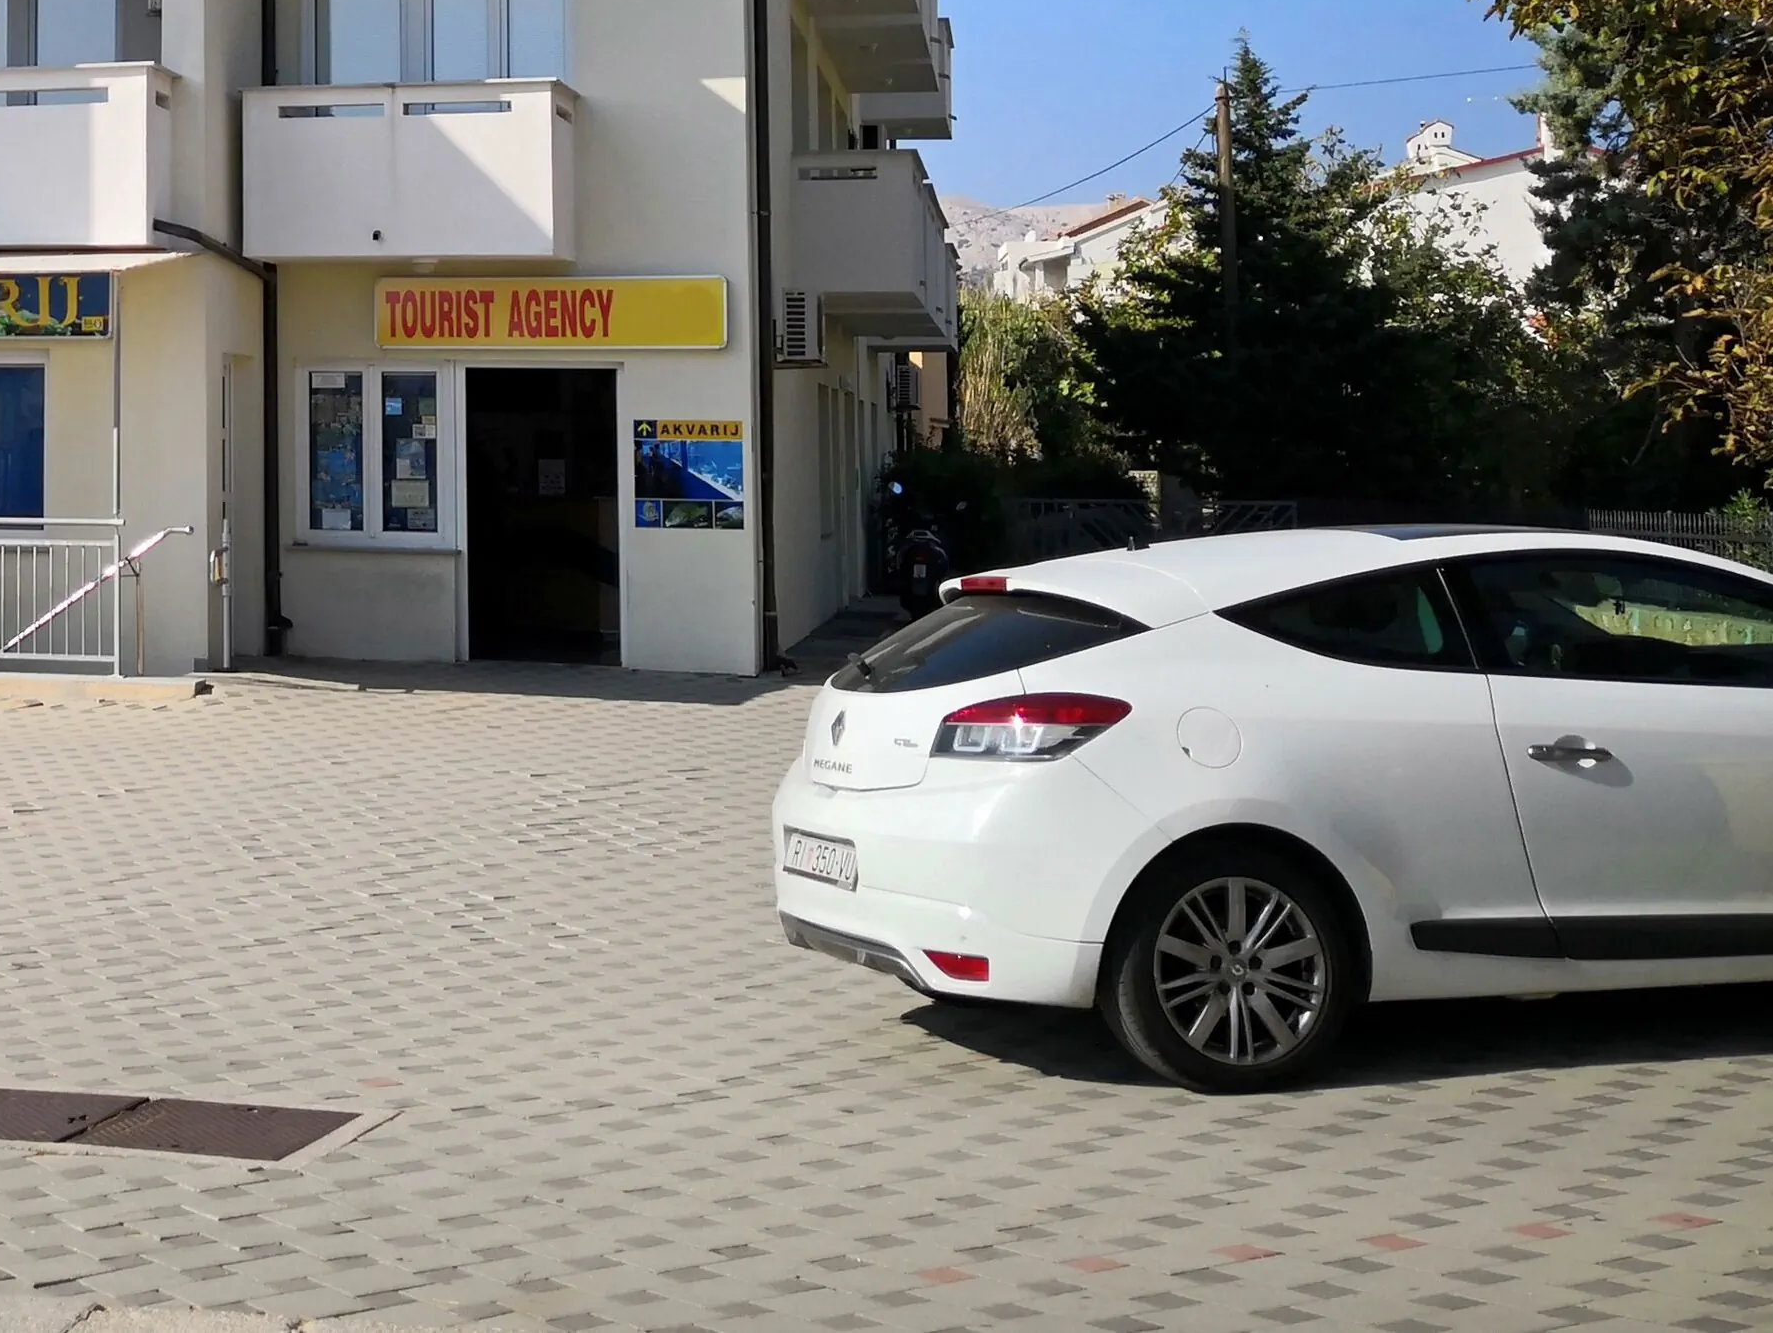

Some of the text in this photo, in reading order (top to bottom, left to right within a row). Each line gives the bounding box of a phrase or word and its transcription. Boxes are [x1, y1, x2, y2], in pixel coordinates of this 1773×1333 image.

[385, 288, 614, 339] TOURIST AGENCY
[660, 423, 739, 437] AKVARIJ
[813, 758, 853, 774] MEGANE
